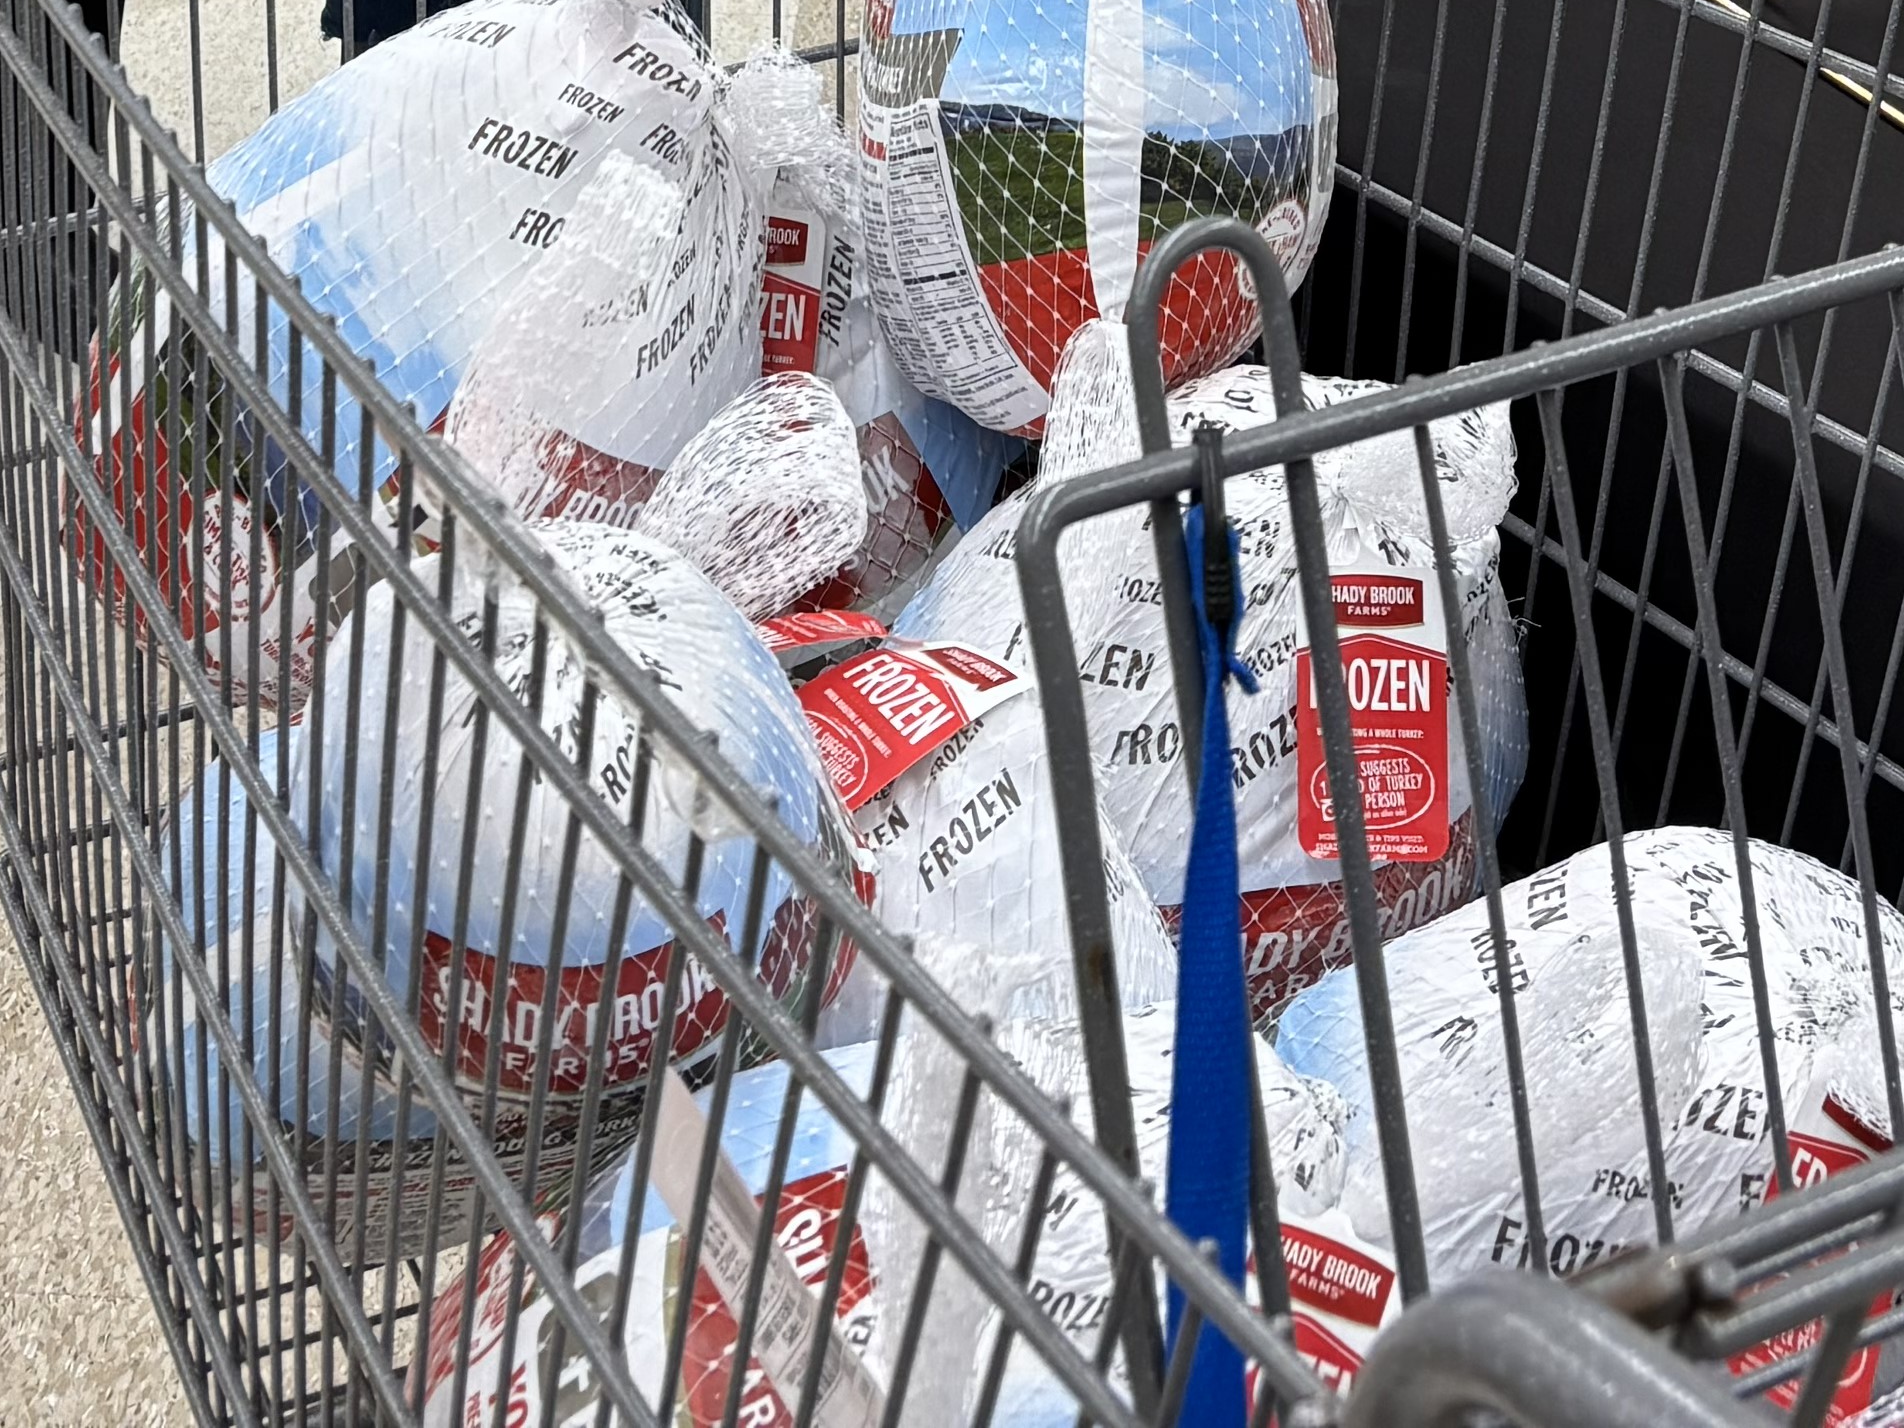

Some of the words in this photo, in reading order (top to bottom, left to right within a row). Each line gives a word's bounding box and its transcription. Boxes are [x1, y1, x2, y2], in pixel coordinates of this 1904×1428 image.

[557, 83, 625, 124] FROZEN
[467, 117, 579, 180] FROZEN
[818, 235, 856, 347] FROZEN
[636, 294, 696, 380] FROZEN
[1347, 605, 1391, 618] FARMS
[1370, 586, 1415, 605] BROOK
[843, 653, 955, 746] FROZEN
[1360, 758, 1411, 776] SUGGESTS
[1369, 775, 1382, 792] OF
[1385, 773, 1424, 791] TURKEY
[1364, 791, 1406, 809] PERSON
[918, 767, 1024, 894] FROZEN
[1323, 1250, 1383, 1301] BROOK
